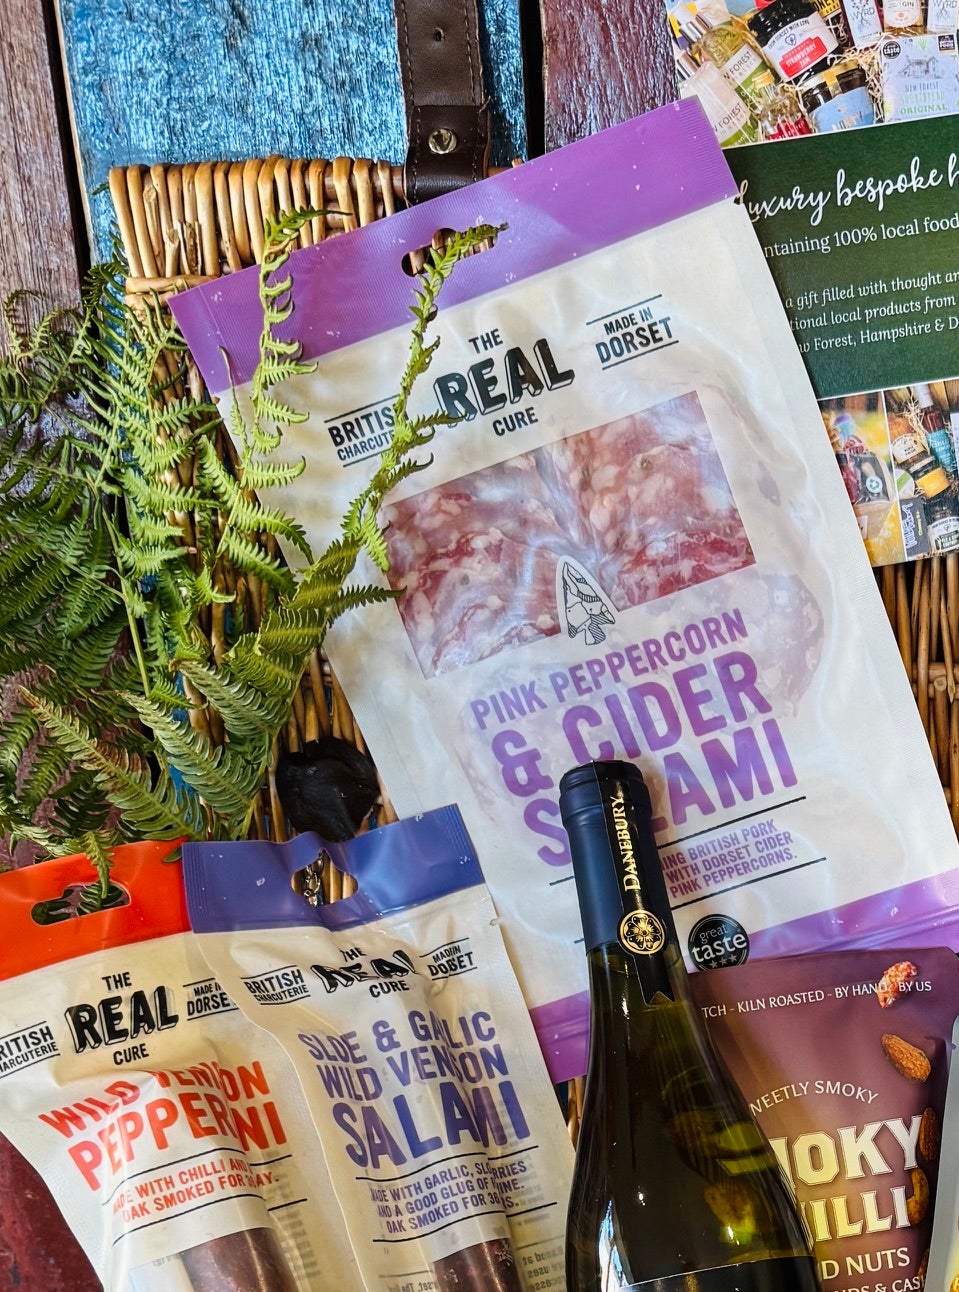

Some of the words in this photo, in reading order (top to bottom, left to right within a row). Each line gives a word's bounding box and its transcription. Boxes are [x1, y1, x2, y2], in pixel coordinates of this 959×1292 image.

[900, 103, 947, 115] ORIGINAL
[836, 156, 944, 211] bespoke
[834, 226, 877, 247] 100%
[881, 220, 919, 239] local
[797, 291, 819, 310] gift
[821, 286, 855, 306] filled
[858, 281, 888, 296] with
[891, 272, 942, 295] thought
[604, 314, 639, 334] MADE
[641, 307, 653, 322] IN
[814, 334, 857, 352] Forest,
[860, 323, 931, 344] Hampshire
[934, 319, 945, 331] &
[469, 329, 503, 354] THE
[596, 317, 675, 364] DORSET
[433, 338, 575, 427] REAL
[492, 407, 539, 436] CURE
[470, 680, 548, 730] PINK
[550, 608, 748, 701] PEPPERCORN
[491, 730, 554, 797] &
[562, 651, 772, 765] CIDER
[609, 795, 641, 892] DANEBURY
[691, 931, 748, 963] taste
[737, 998, 766, 1014] KILN
[768, 988, 824, 1010] ROASTED
[835, 986, 850, 1000] BY
[64, 986, 179, 1053] REAL
[38, 1081, 141, 1138] WILD
[815, 1081, 878, 1105] SMOKY
[332, 1080, 530, 1168] SALAMI
[135, 1175, 176, 1197] WITH
[179, 1159, 226, 1184] CHILLI
[123, 1202, 150, 1222] OAK
[153, 1182, 215, 1211] SMOKED
[219, 1175, 245, 1190] FOR
[386, 1220, 405, 1234] OAK
[410, 1200, 459, 1230] SMOKED
[462, 1194, 487, 1210] FOR
[846, 1247, 910, 1278] NUTS
